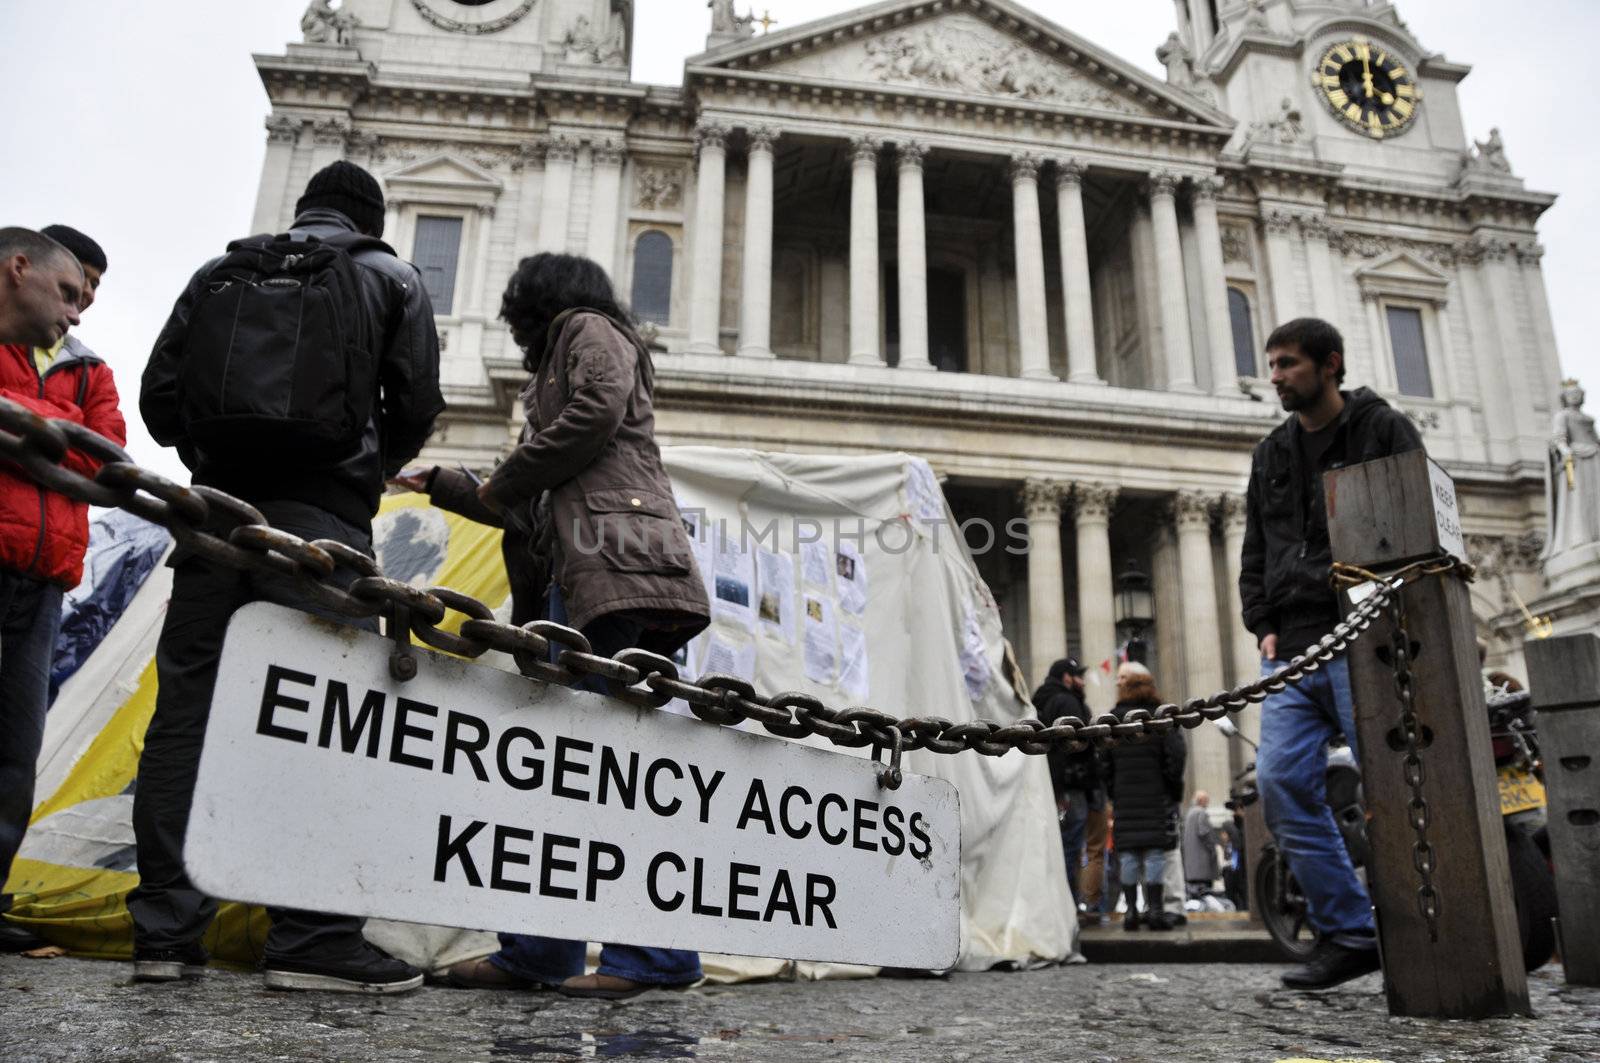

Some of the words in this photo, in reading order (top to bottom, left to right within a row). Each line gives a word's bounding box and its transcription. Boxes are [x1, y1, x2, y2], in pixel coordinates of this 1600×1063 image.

[1435, 482, 1454, 509] KEEP
[1437, 510, 1462, 541] CLEAR
[256, 664, 726, 823] EMERGENCY
[736, 778, 932, 862] ACCESS
[433, 815, 626, 903] KEEP
[646, 851, 838, 930] CLEAR
